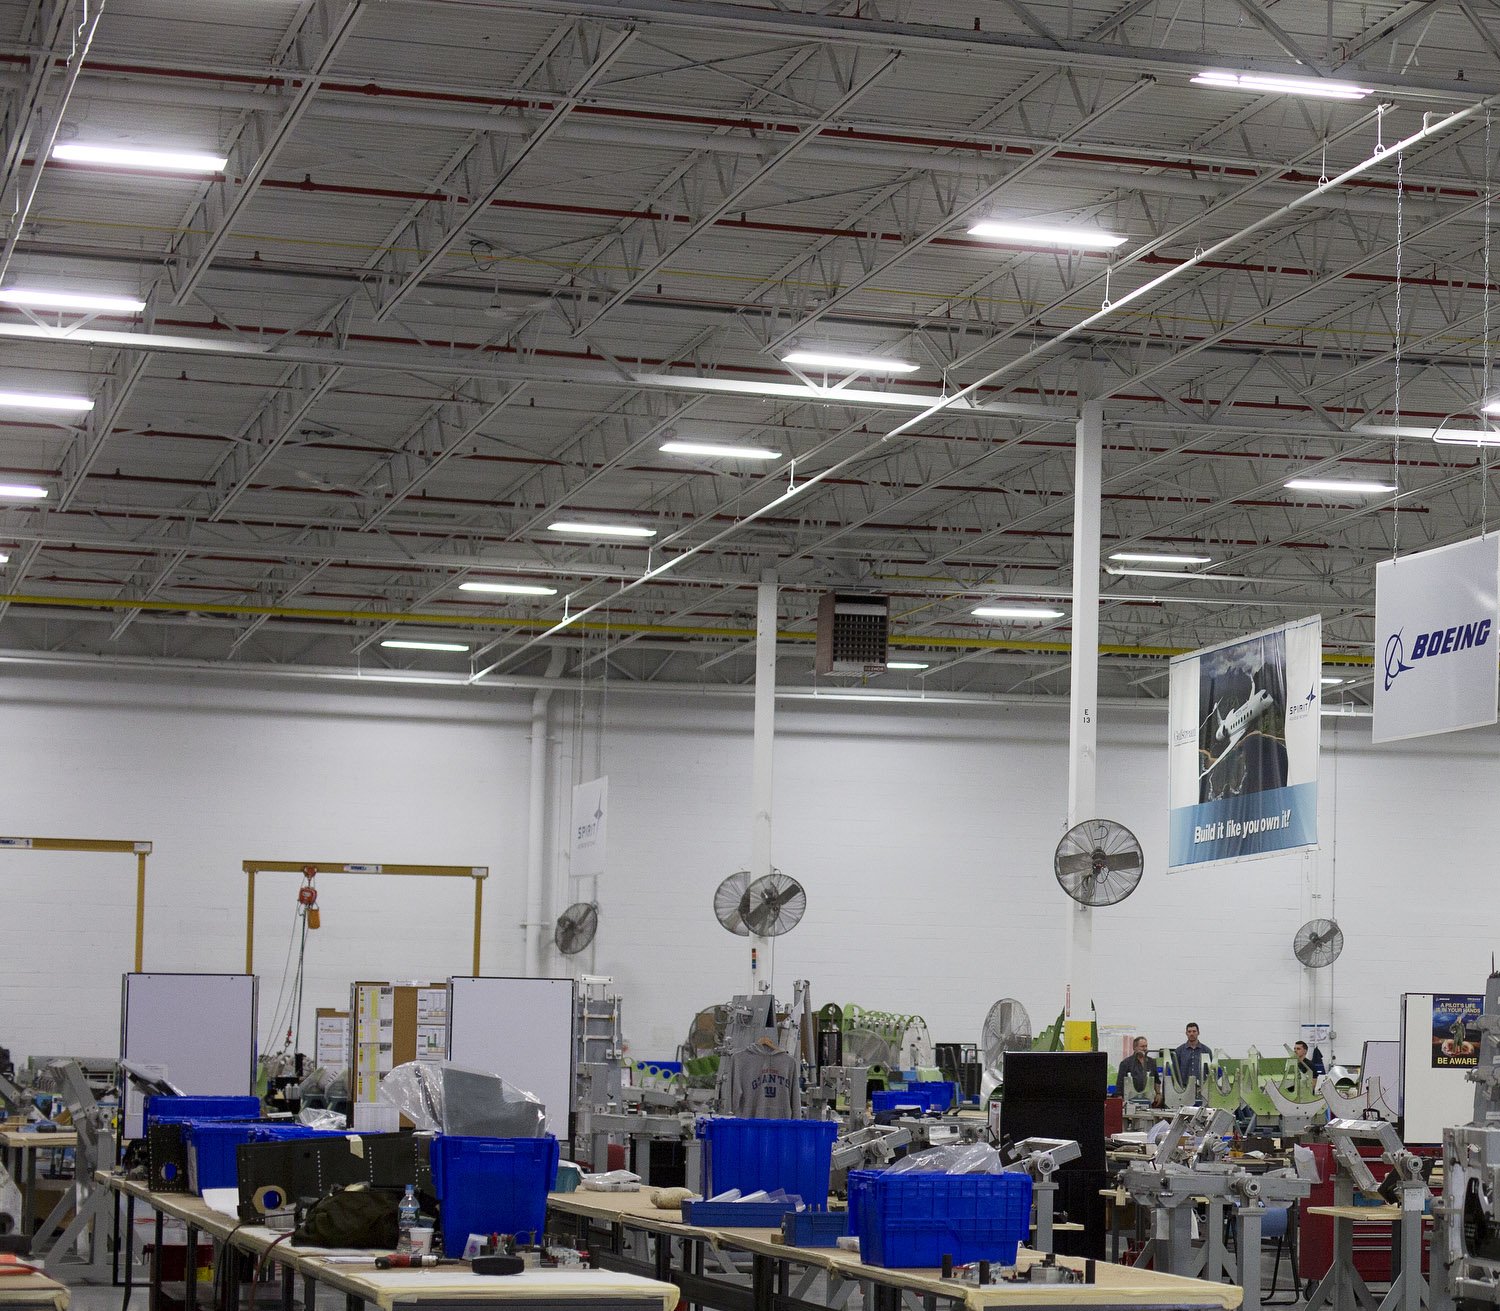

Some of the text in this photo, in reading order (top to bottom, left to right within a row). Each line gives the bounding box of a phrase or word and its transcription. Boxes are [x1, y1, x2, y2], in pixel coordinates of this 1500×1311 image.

[1410, 618, 1492, 660] BOEING
[1289, 703, 1309, 715] SPIRIT
[578, 822, 596, 839] SPIRIT
[1194, 809, 1291, 844] Build it like you own it!
[1437, 1057, 1478, 1065] BE AWARE
